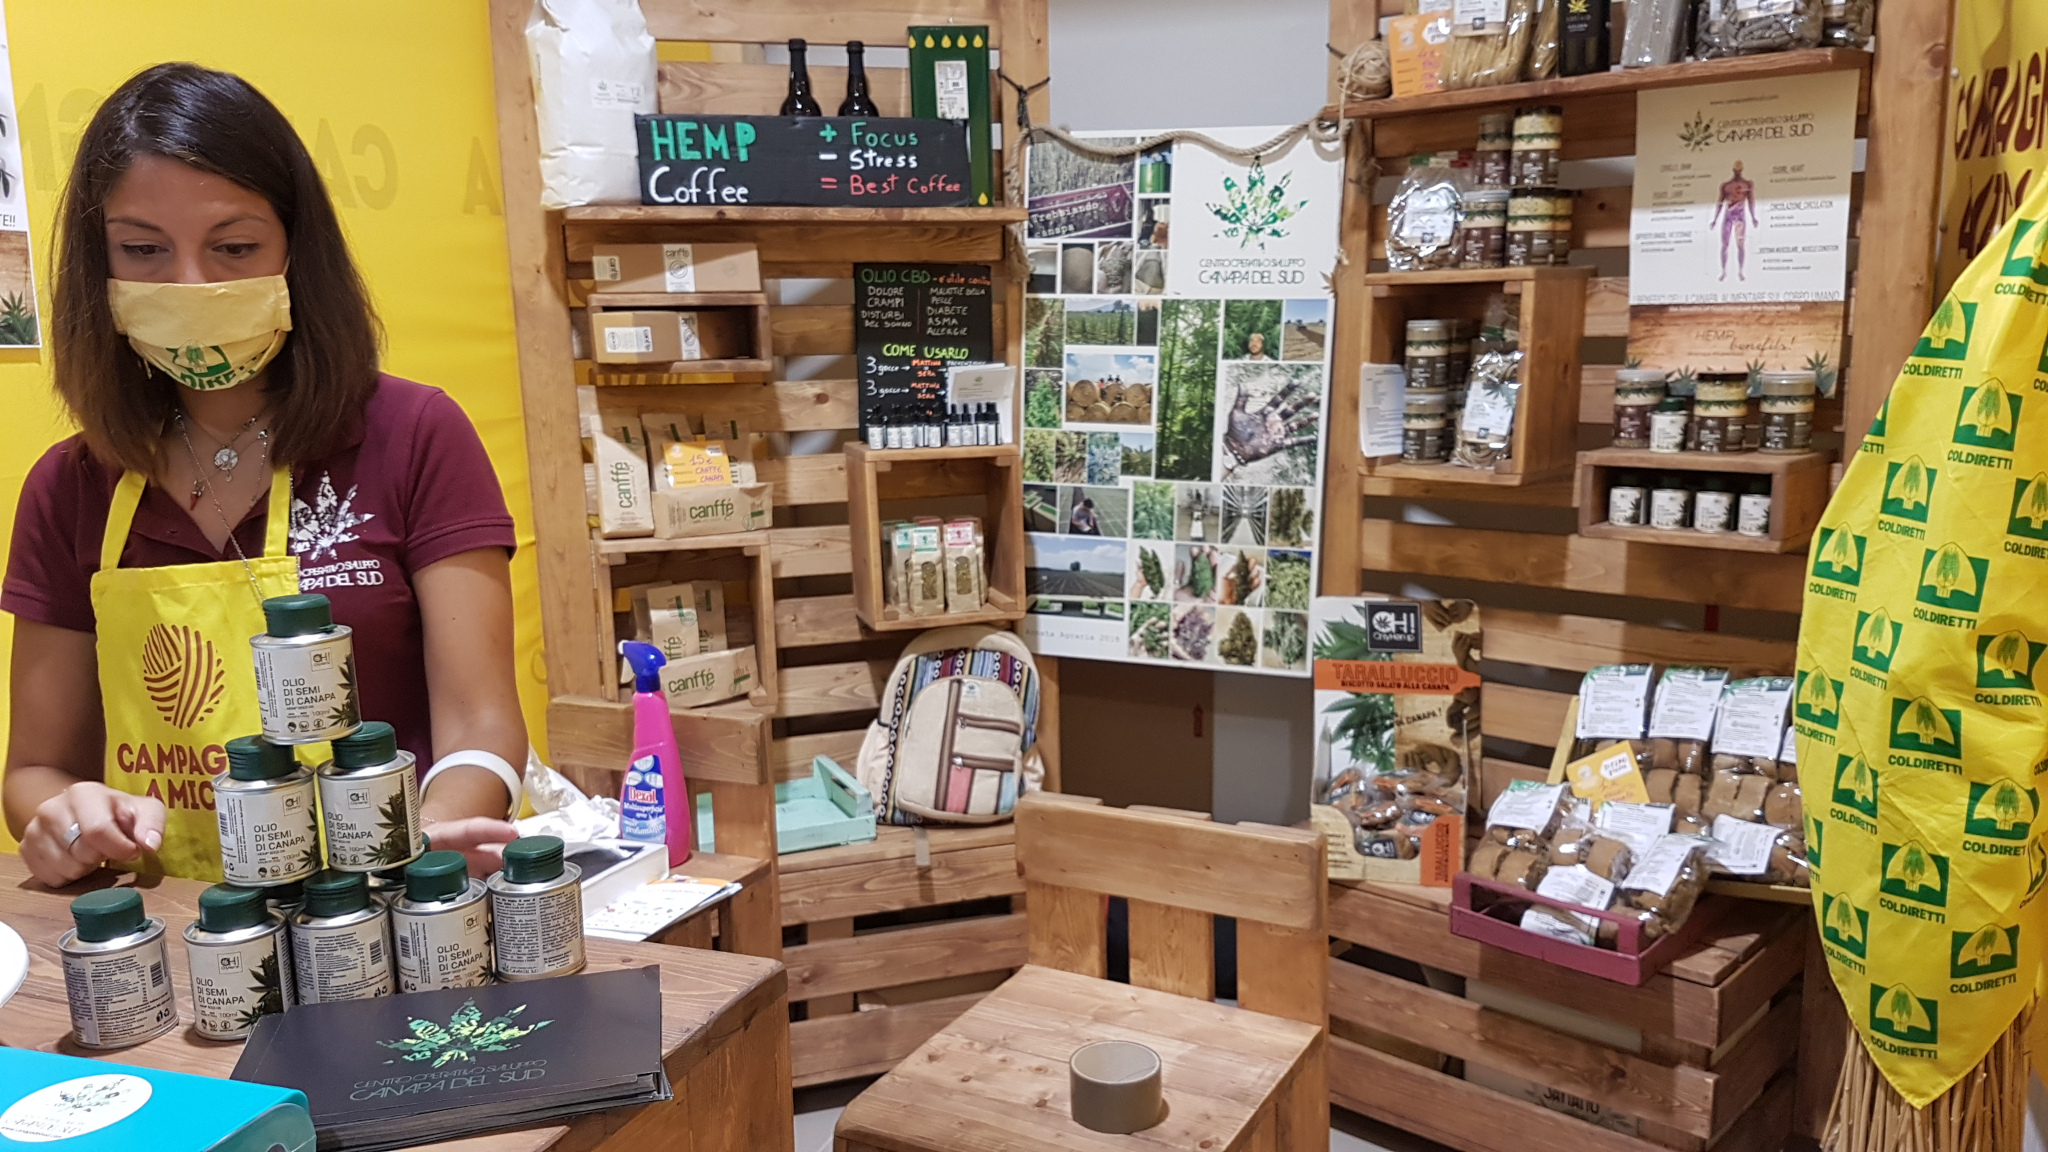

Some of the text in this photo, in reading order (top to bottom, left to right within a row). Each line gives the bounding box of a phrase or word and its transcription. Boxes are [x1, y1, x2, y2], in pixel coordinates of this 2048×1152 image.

[850, 122, 918, 148] Focus
[1789, 122, 1814, 137] SUD
[650, 120, 756, 162] HEMP
[849, 149, 918, 170] Stress
[649, 166, 749, 204] Coffee
[849, 174, 899, 195] Best
[907, 176, 961, 195] Coffee
[861, 268, 897, 284] OLIO
[901, 269, 931, 284] CBD
[1199, 270, 1305, 284] CANAPA DEL SUD
[868, 286, 904, 296] DOLORE
[867, 298, 904, 308] CRAMPI
[927, 306, 968, 316] DIABETE
[928, 317, 959, 326] ASMA
[882, 343, 969, 360] COME USARLO
[866, 356, 877, 374] 3
[1903, 362, 1963, 380] COLDIRETTI
[866, 379, 877, 396] 3
[1947, 450, 2013, 471] COLDIRETTI
[610, 461, 634, 509] canffé
[689, 498, 735, 521] canffé
[1878, 519, 1926, 541] COLDIRETTI
[326, 572, 355, 588] DEL
[356, 570, 384, 586] SUD
[1808, 582, 1857, 603] COLDIRETTI
[1913, 607, 1977, 630] COLDIRETTI
[668, 668, 716, 694] canffé
[1332, 662, 1459, 685] TARALLUCCIO
[1850, 666, 1887, 691] COLDIRETTI
[282, 678, 305, 688] OLIO
[283, 686, 321, 697] DI SEMI
[1422, 683, 1450, 691] CANAPA
[284, 692, 337, 706] DI CANAPA
[1974, 693, 2042, 708] COLDIRETTI
[1889, 754, 1963, 775] COLDIRETTI
[629, 786, 658, 804] Dexal
[328, 812, 343, 821] OLIO
[329, 821, 357, 830] DI SEMI
[1830, 808, 1878, 835] COLDIRETTI
[253, 823, 278, 833] OLIO
[255, 830, 292, 842] DI SEMI
[337, 831, 374, 839] CANAPA
[256, 836, 306, 852] DI CANAPA
[1879, 897, 1946, 925] COLDIRETTI
[437, 943, 460, 954] OLIO
[438, 948, 472, 963] DI SEMI
[439, 952, 483, 972] DI CANAPA
[1824, 943, 1866, 976] COLDIRETTI
[196, 977, 213, 987] OLIO
[197, 986, 228, 996] DI SEMI
[1950, 974, 2018, 994] COLDIRETTI
[198, 995, 245, 1005] DI CANAPA
[1870, 1034, 1938, 1060] COLDIRETTI
[349, 1068, 546, 1101] CANAPA DEL SUD
